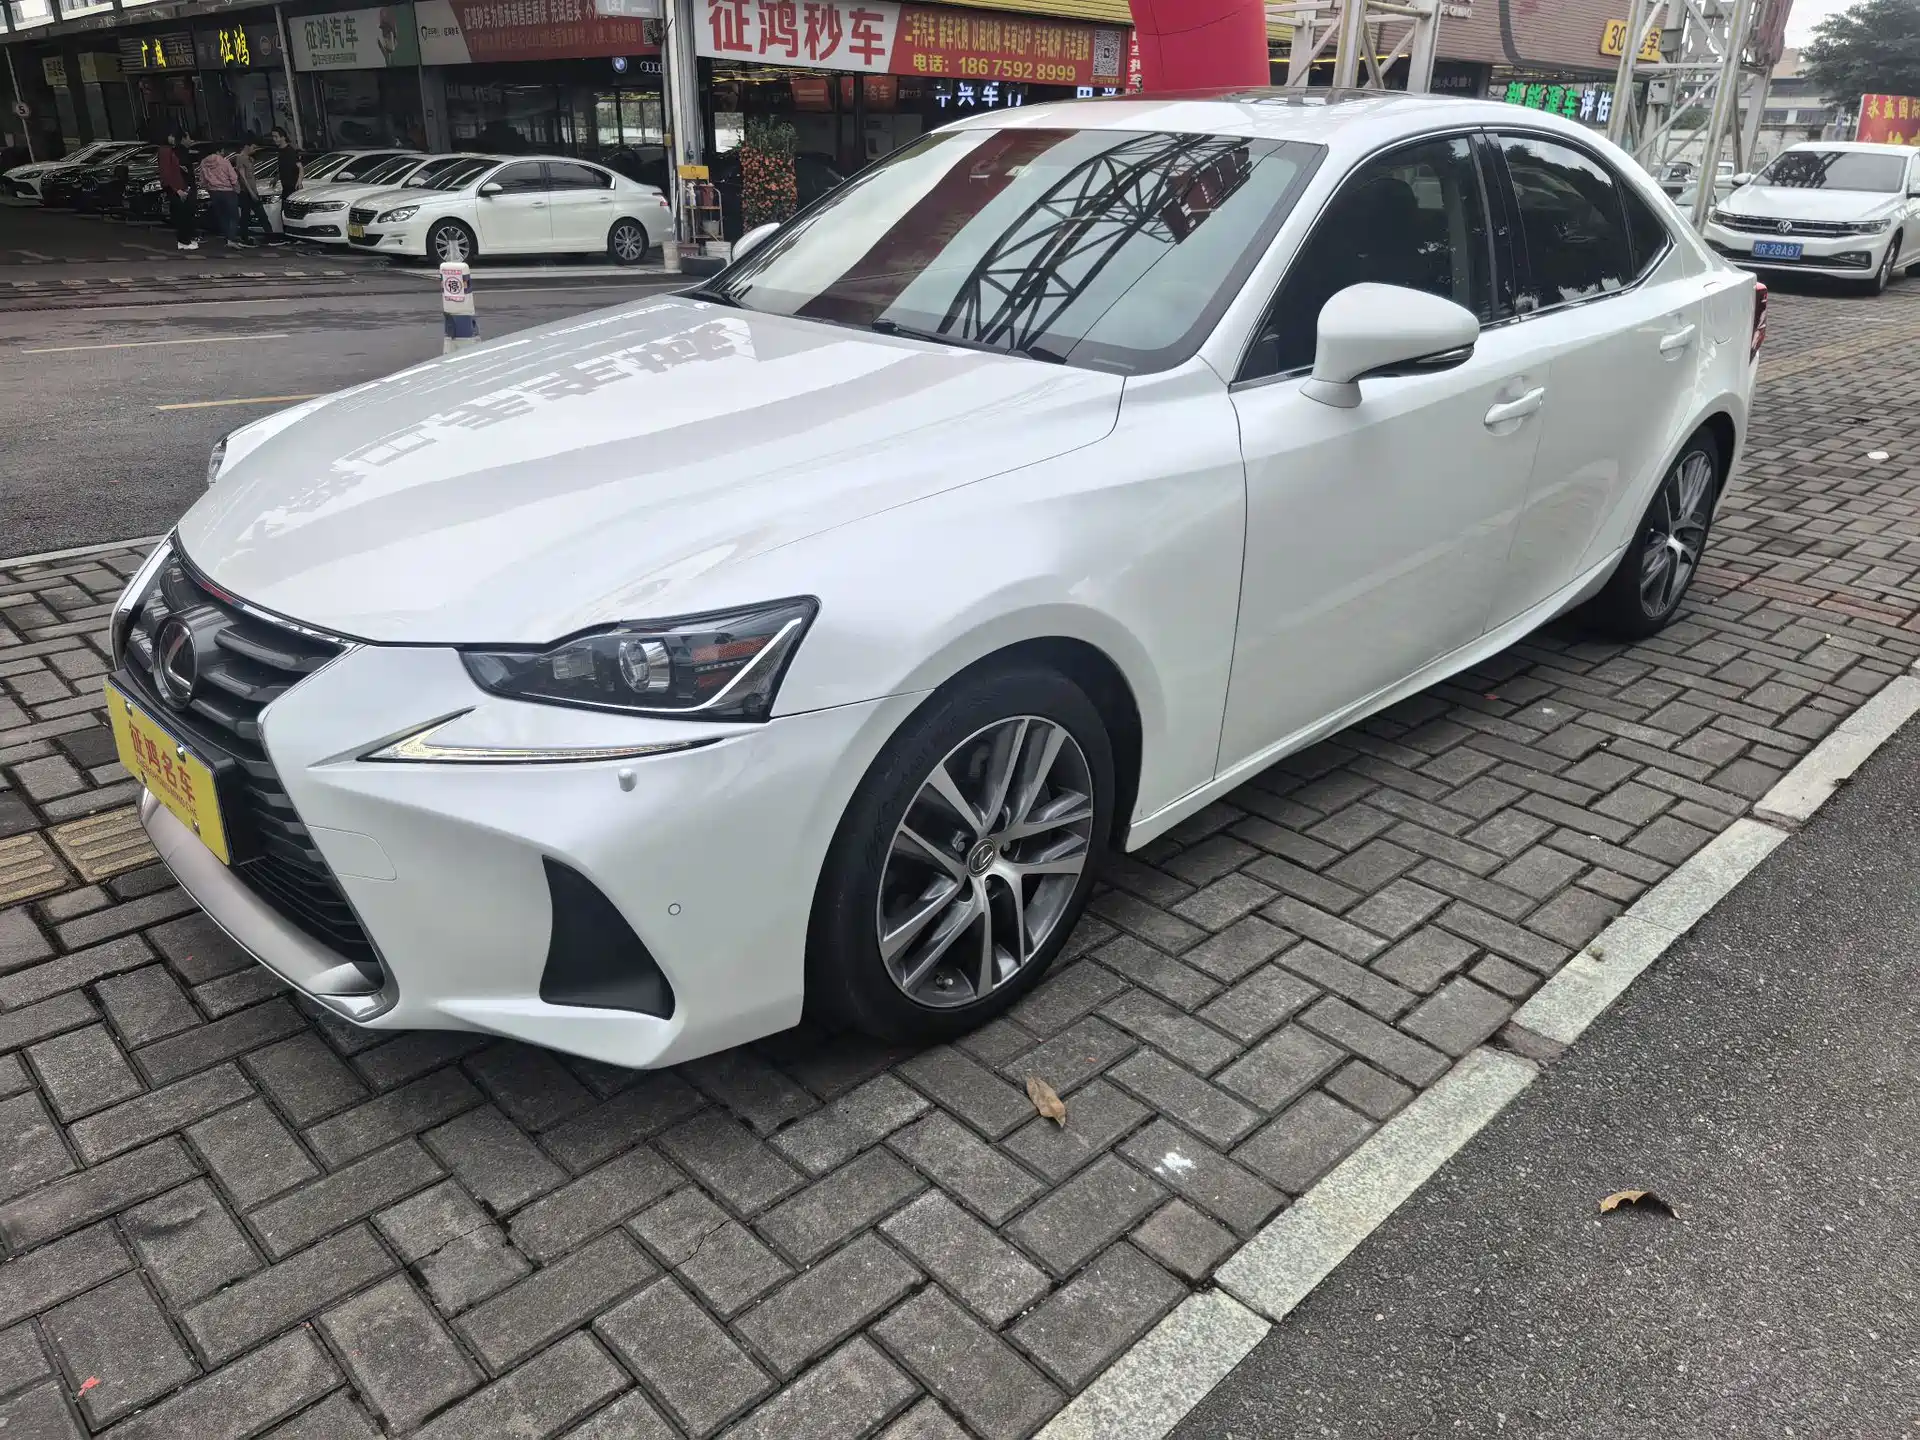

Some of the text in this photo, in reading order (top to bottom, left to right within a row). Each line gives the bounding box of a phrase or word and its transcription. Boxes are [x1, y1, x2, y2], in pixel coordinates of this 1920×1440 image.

[219, 24, 250, 68] 征鸿
[304, 15, 359, 52] 征鸿汽车
[708, 0, 886, 66] 征鸿秒车
[904, 12, 936, 49] 二手汽车
[958, 56, 988, 75] 186
[992, 59, 1033, 79] 7592
[1036, 63, 1076, 81] 8999
[445, 280, 460, 293] 停
[128, 719, 197, 803] 征鸿名车
